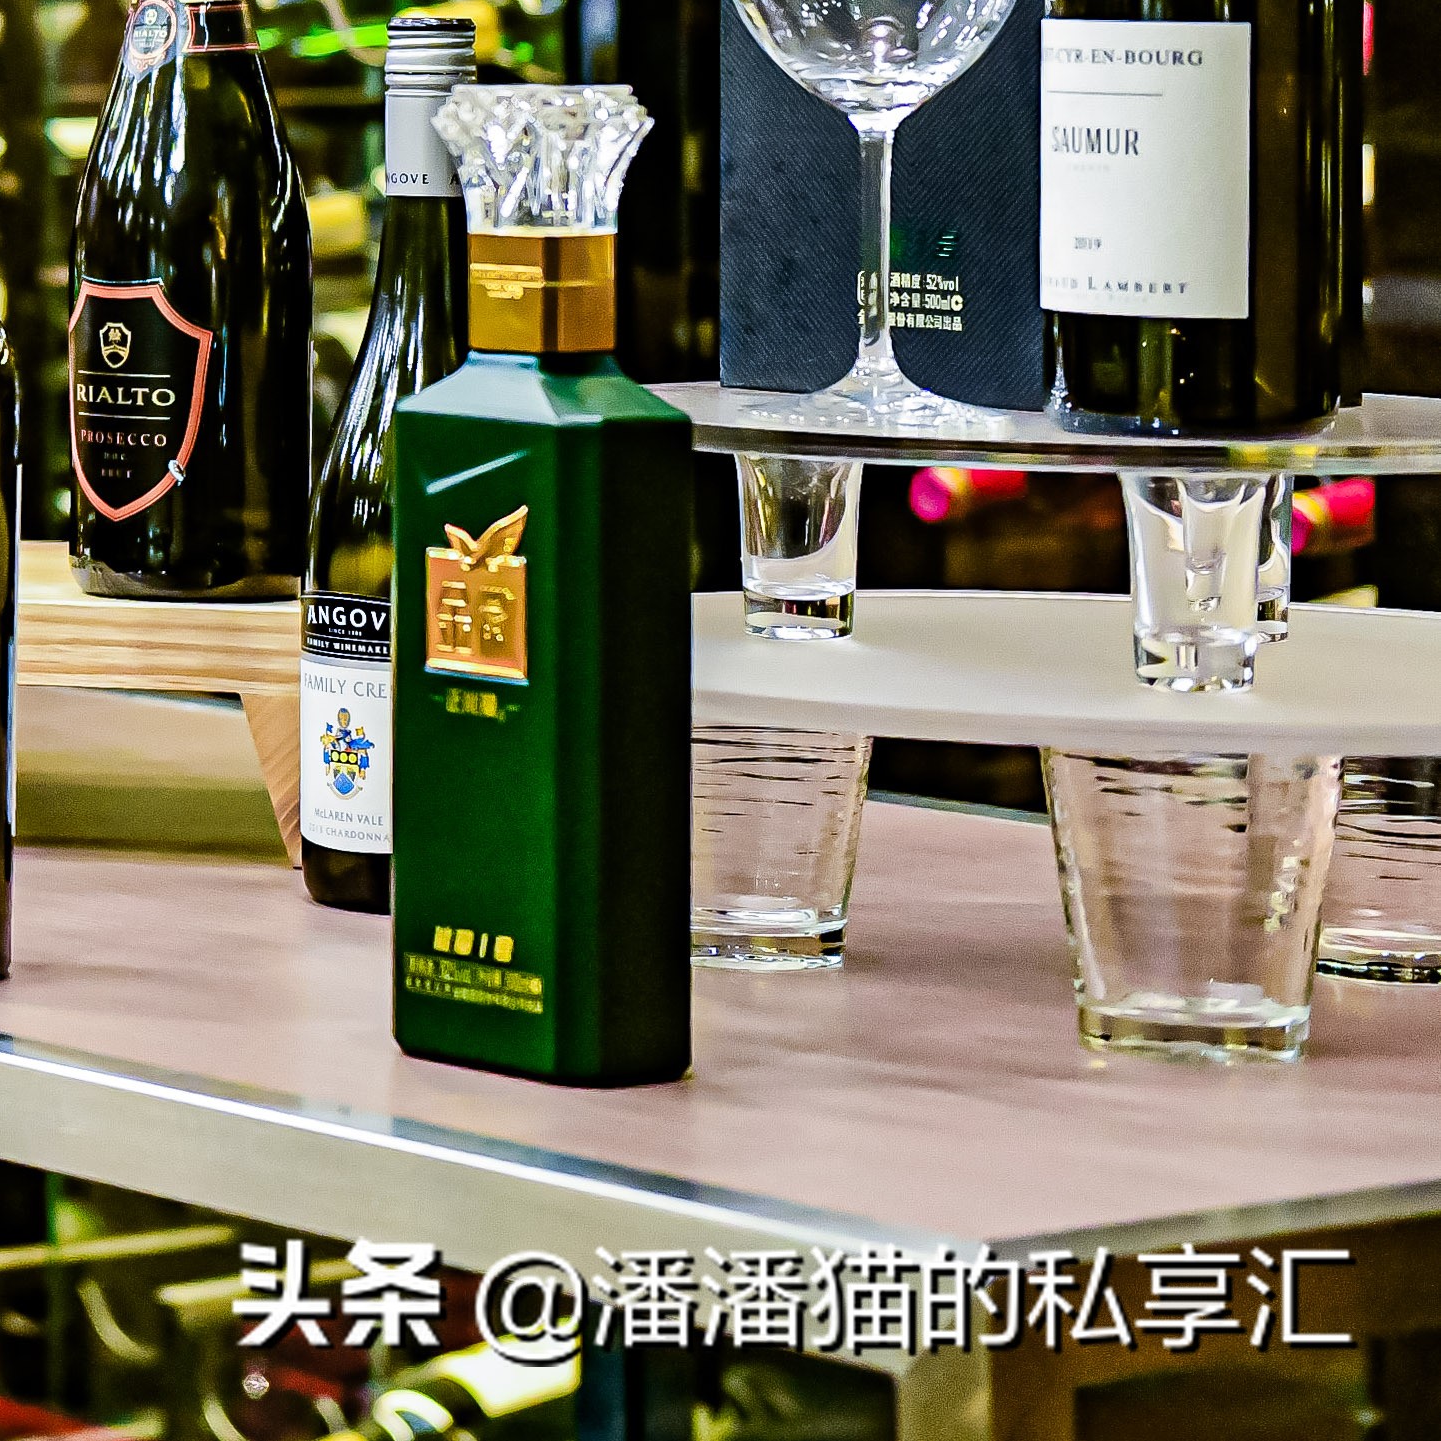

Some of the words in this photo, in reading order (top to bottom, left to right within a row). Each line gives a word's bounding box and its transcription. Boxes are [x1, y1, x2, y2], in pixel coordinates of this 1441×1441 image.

[1052, 126, 1140, 156] SAUMUR
[1087, 276, 1189, 294] LAMBERT
[76, 383, 176, 407] RIALTO
[80, 428, 167, 448] PROSECCO
[307, 604, 387, 631] ANGOV
[304, 672, 347, 697] FAMILY
[314, 807, 353, 823] McLAREN
[357, 813, 384, 827] VALE
[325, 826, 391, 844] CHARDONNA
